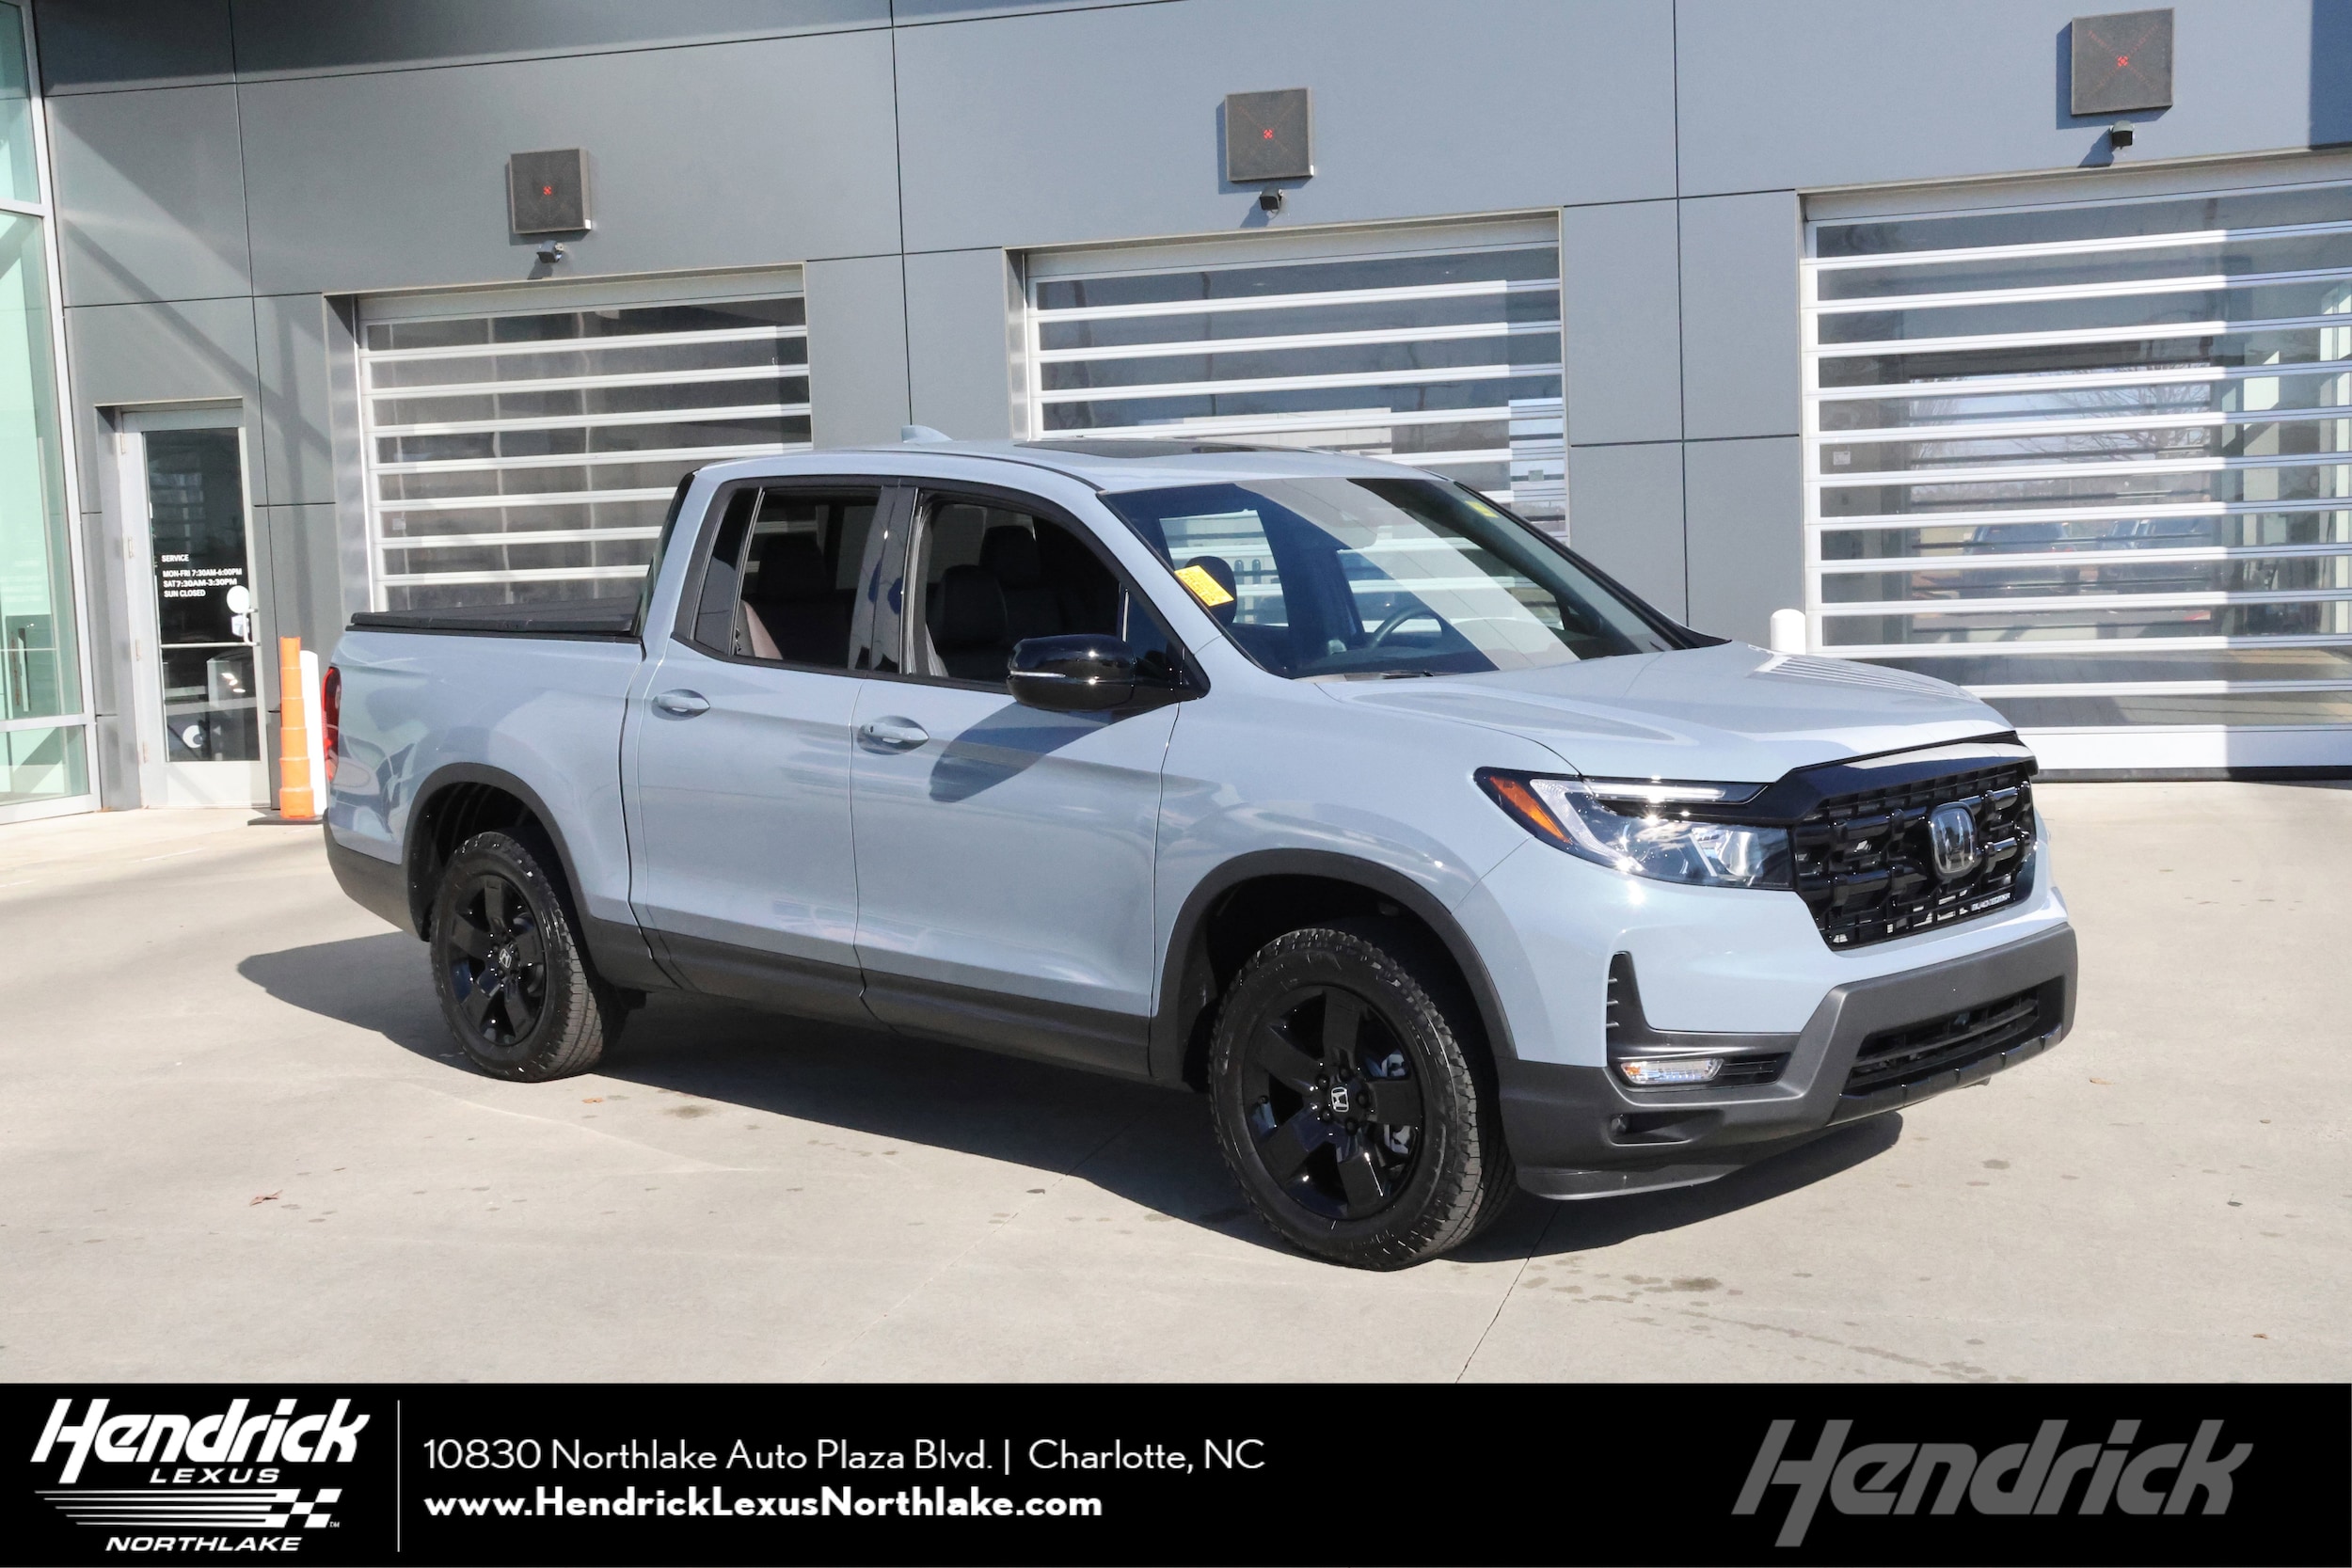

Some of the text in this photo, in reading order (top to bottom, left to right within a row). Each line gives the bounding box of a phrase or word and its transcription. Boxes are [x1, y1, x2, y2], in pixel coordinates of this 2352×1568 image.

[162, 554, 190, 562] SERVICE
[163, 568, 242, 578] MON-FRI 7:30AM-6:00PM
[179, 589, 206, 597] CLOSED
